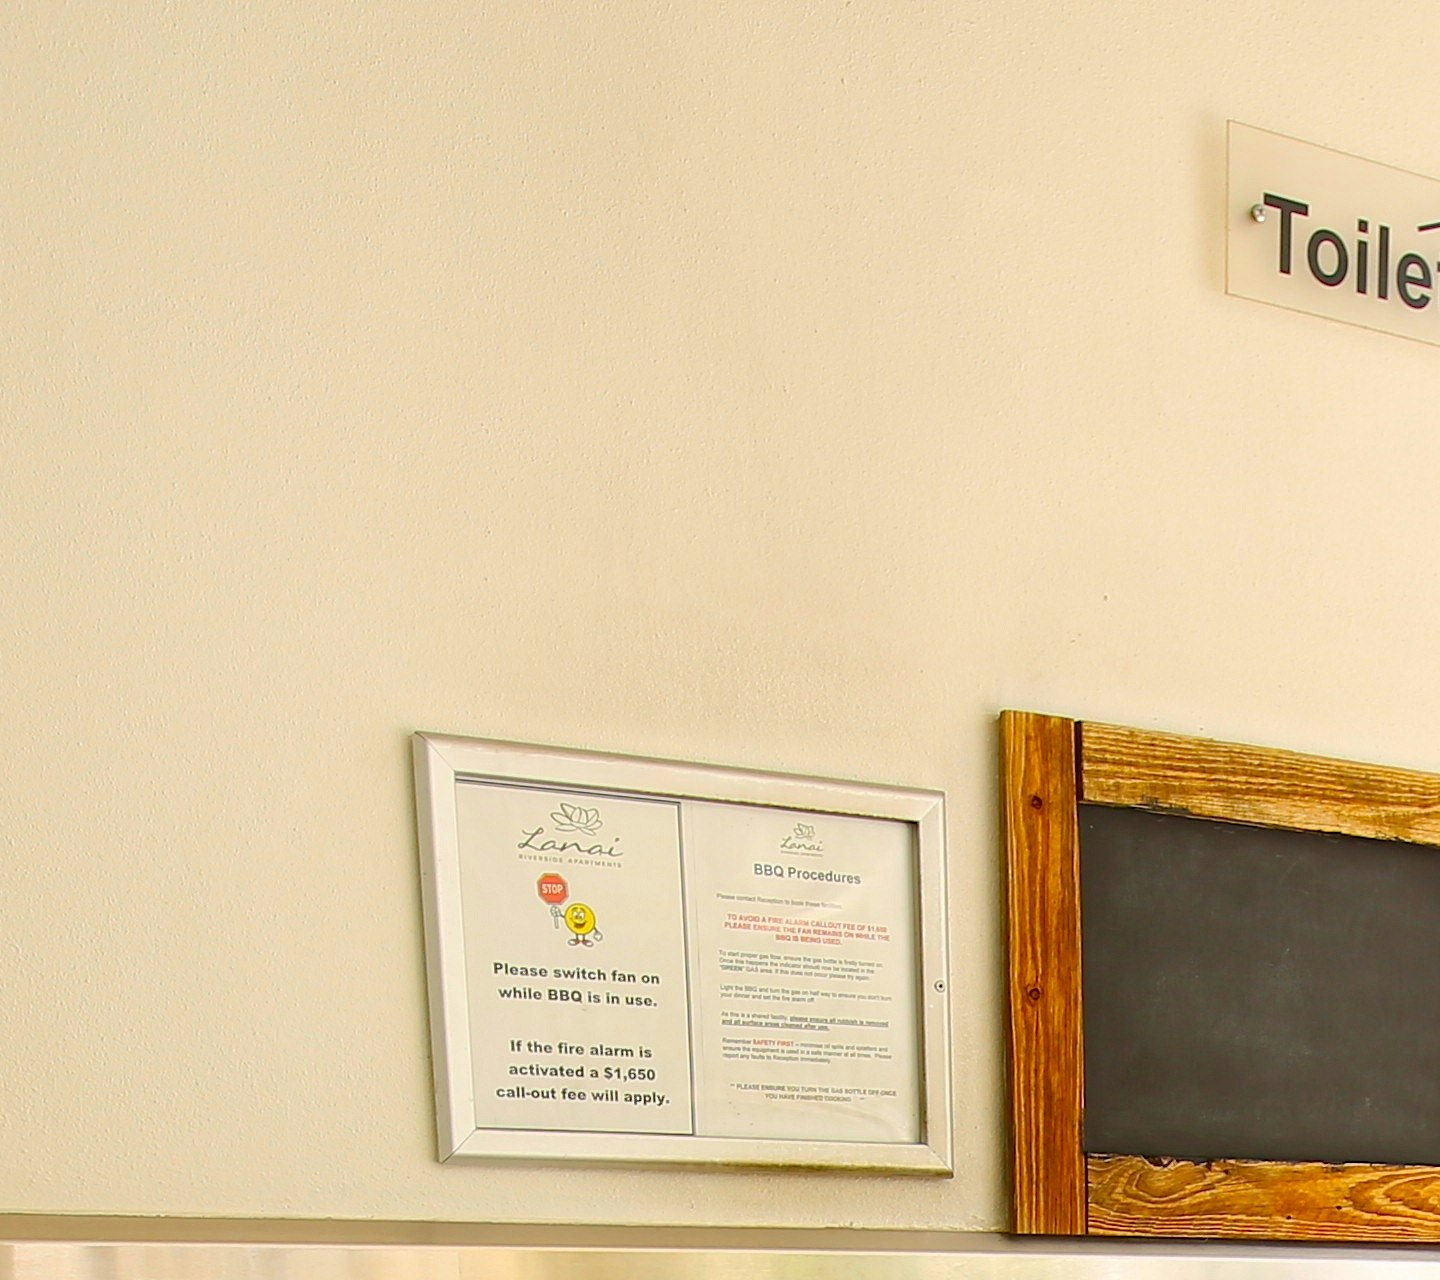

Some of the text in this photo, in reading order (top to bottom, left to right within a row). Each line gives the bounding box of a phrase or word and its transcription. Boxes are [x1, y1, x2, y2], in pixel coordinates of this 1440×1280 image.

[517, 827, 624, 857] Lanai
[780, 836, 824, 852] Lanai
[754, 863, 861, 884] BBQ Procedures
[542, 883, 564, 894] STOP
[493, 962, 660, 984] Please switch fan on
[498, 987, 657, 1007] while BBQ is in use.
[510, 1040, 652, 1058] If the fire alarm is
[752, 1038, 776, 1046] SAFETY
[776, 1039, 795, 1047] FIRST
[509, 1064, 656, 1082] activated a $1,650
[496, 1086, 670, 1106] call-out fee will apply.
